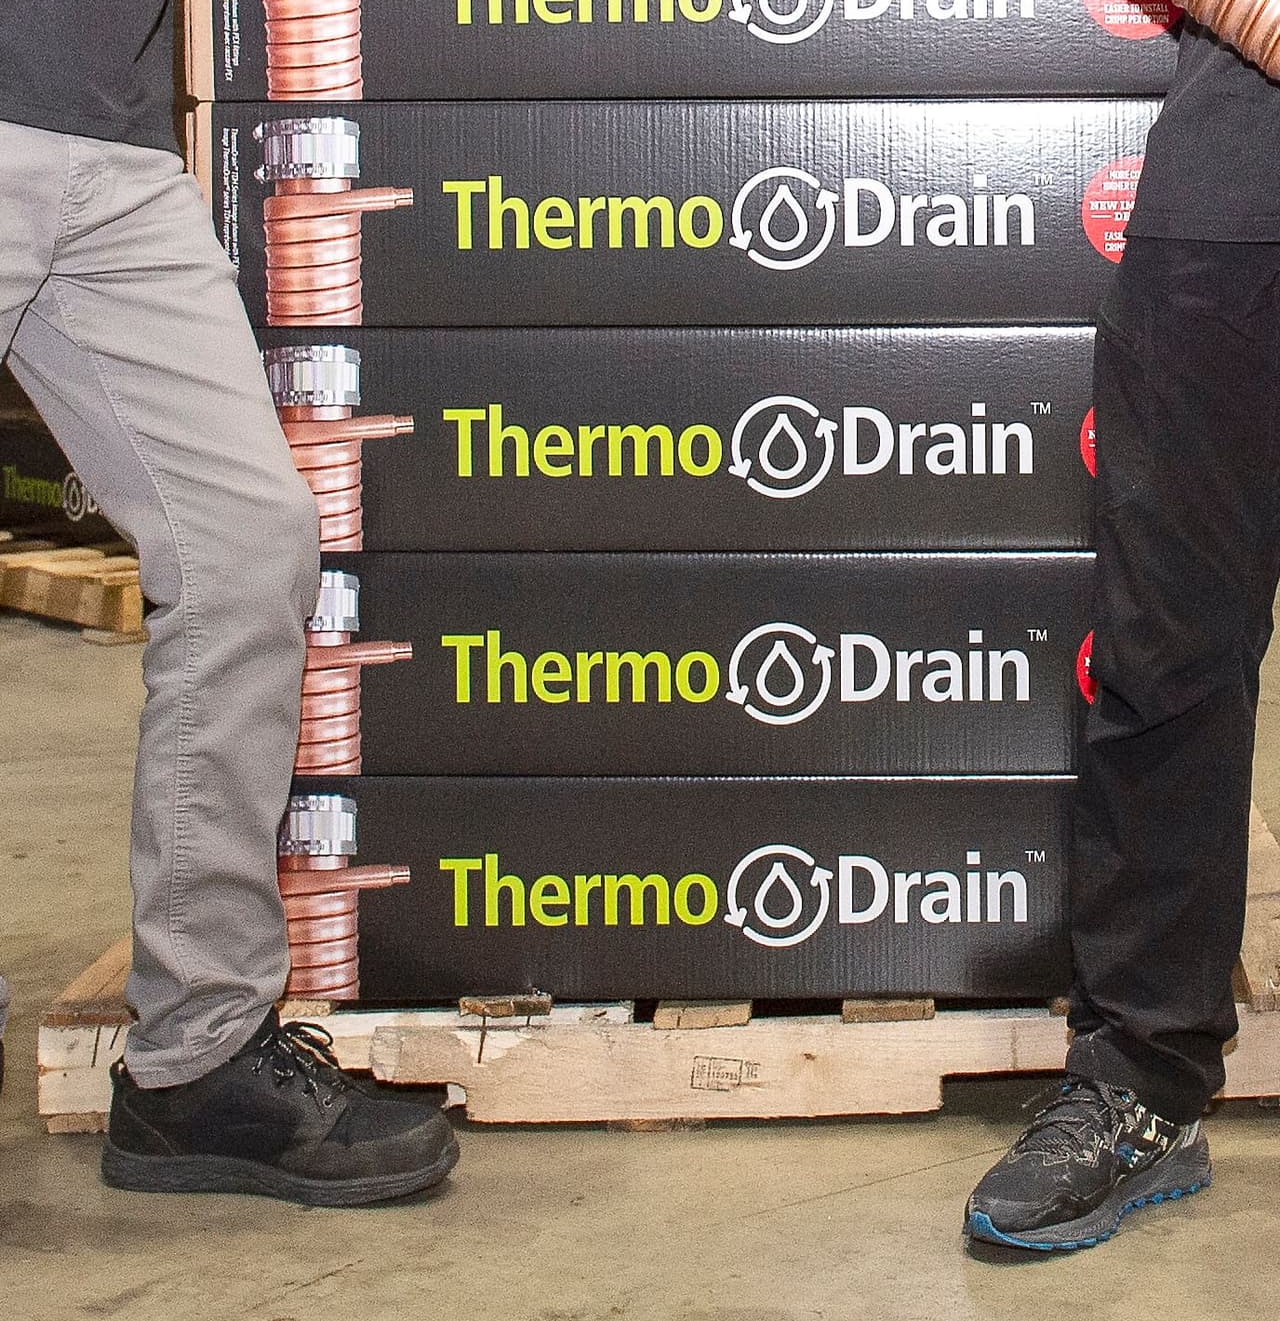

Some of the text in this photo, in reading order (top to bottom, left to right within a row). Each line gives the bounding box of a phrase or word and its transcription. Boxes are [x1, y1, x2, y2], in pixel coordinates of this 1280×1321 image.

[442, 175, 723, 250] Thermo
[843, 174, 1036, 247] Drain
[1089, 200, 1118, 211] NEW
[1104, 241, 1126, 252] CRIM
[442, 403, 723, 477] Thermo
[842, 402, 1034, 476] Drain
[441, 630, 721, 704] Thermo
[839, 630, 1031, 703] Drain
[439, 853, 719, 928] Thermo
[837, 851, 1029, 924] Drain
